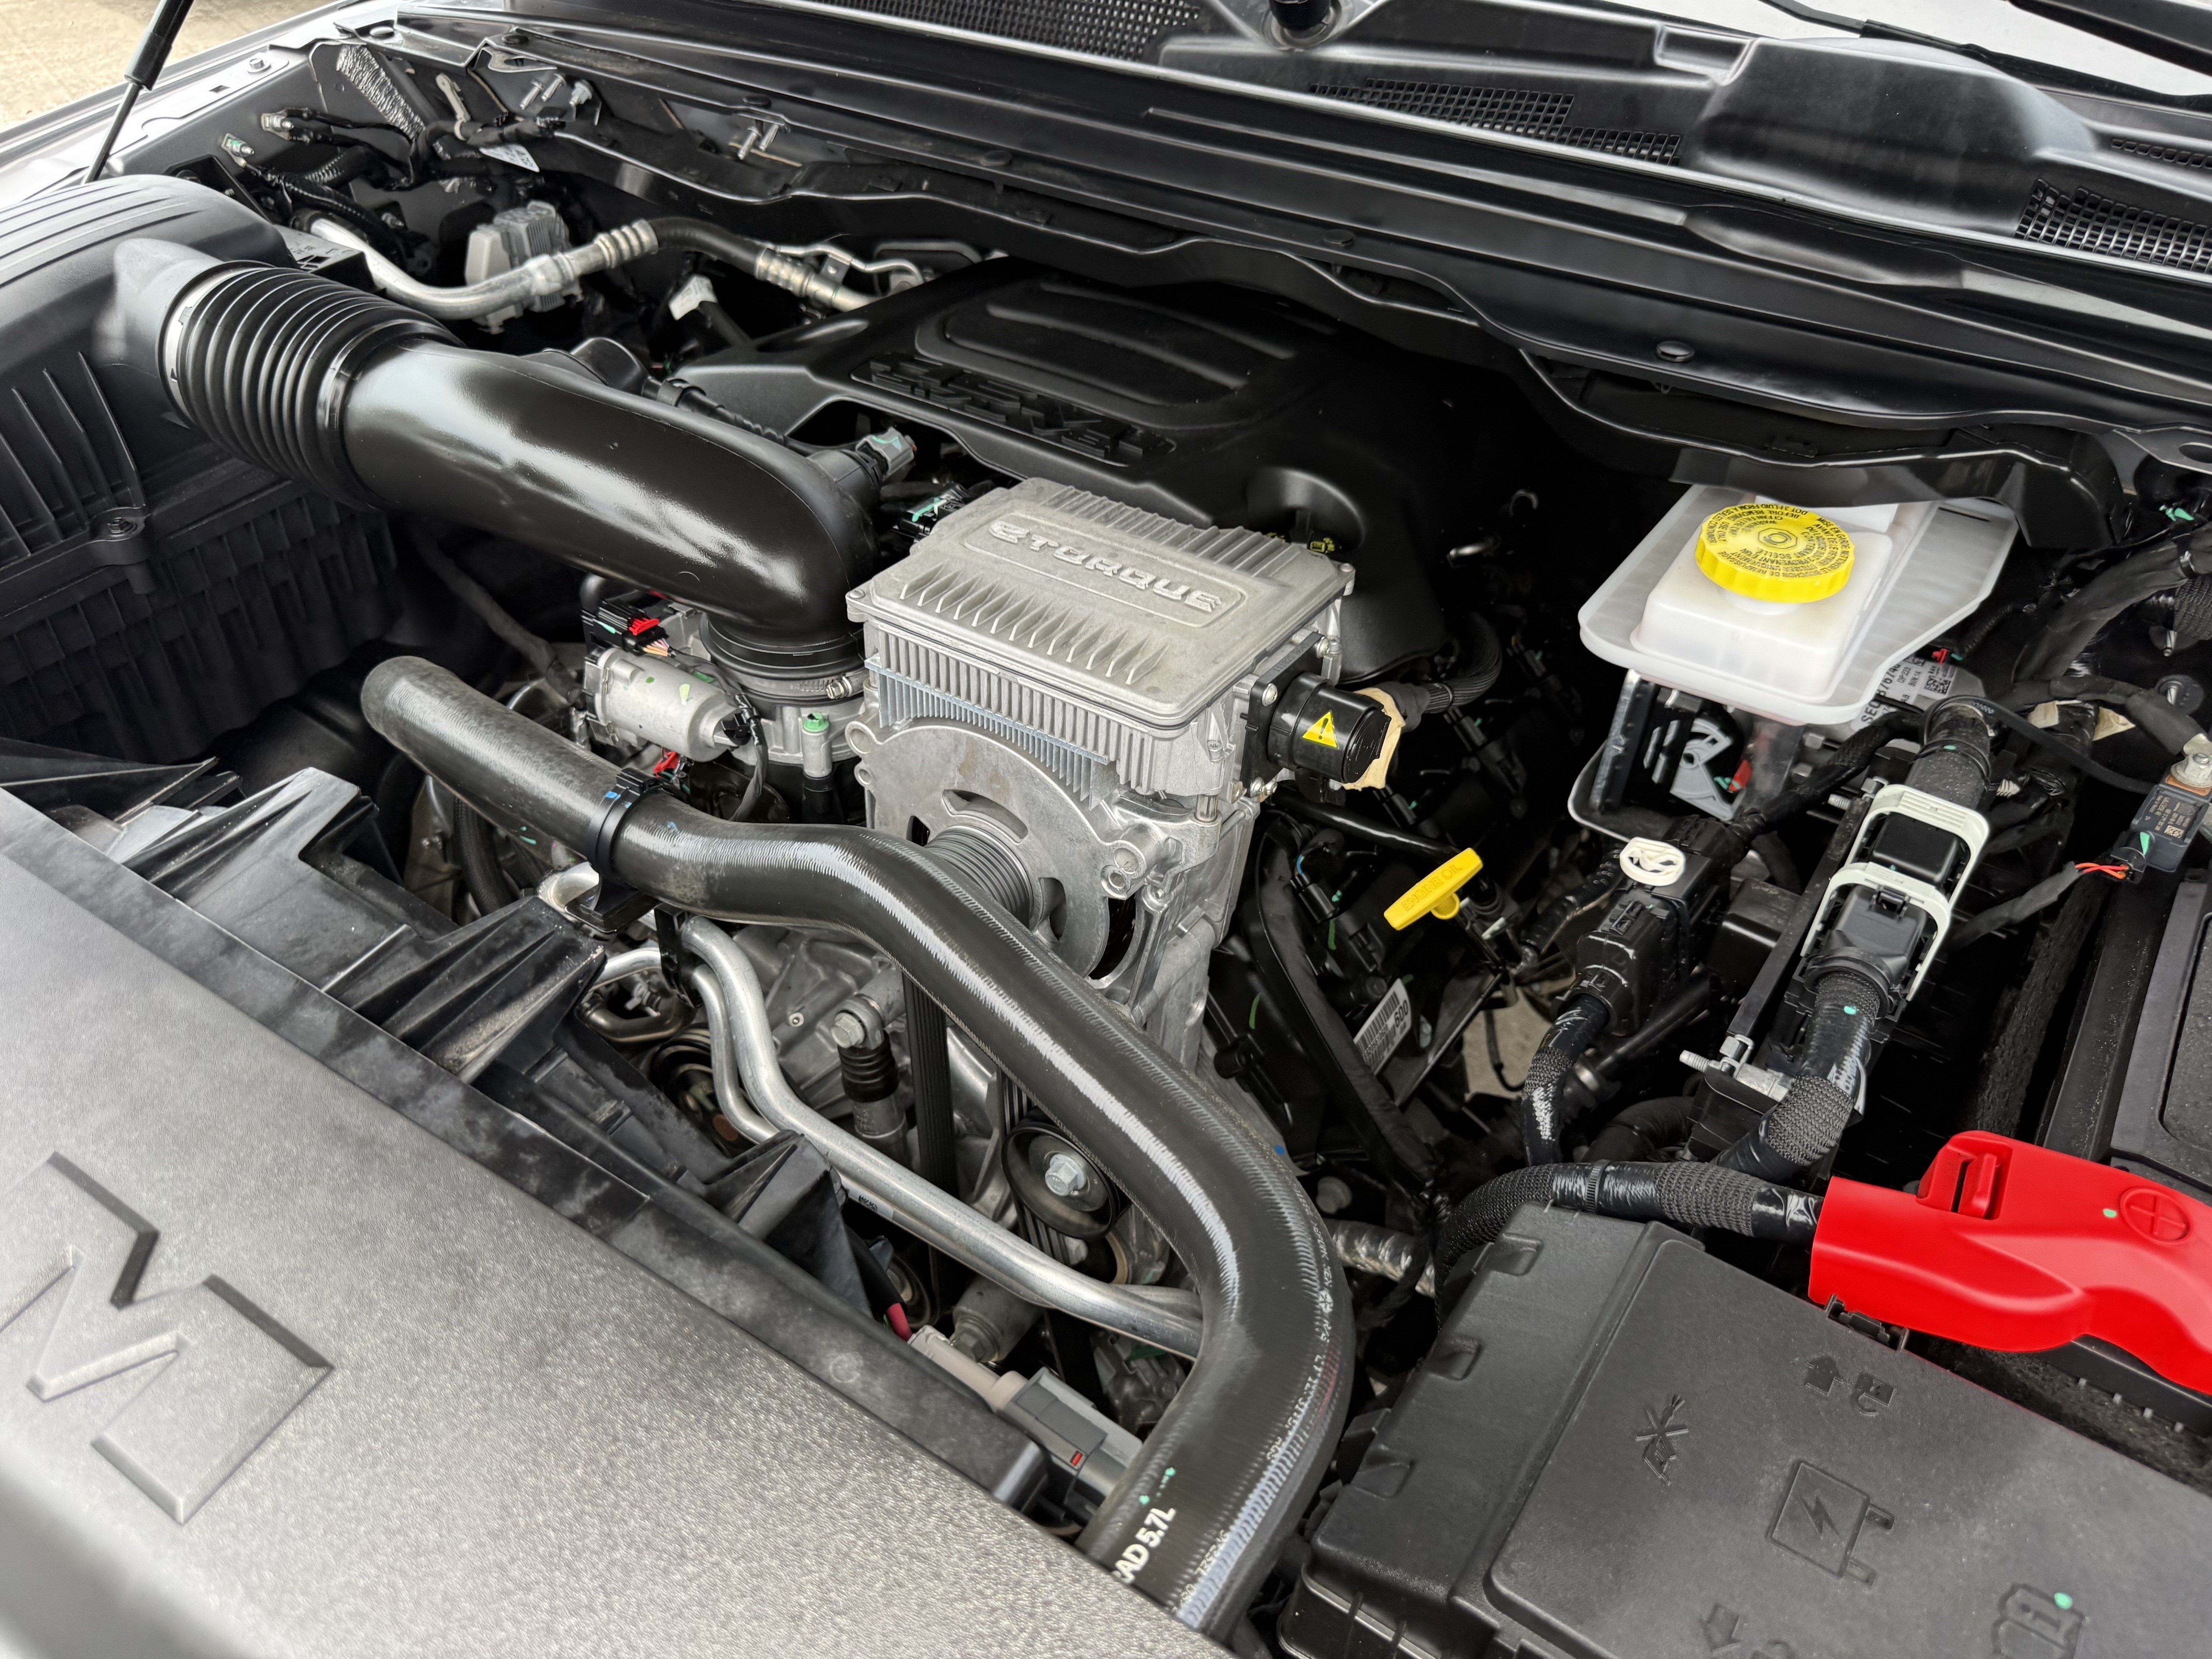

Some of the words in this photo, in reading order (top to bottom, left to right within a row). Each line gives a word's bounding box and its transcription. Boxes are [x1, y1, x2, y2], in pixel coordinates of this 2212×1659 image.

[1711, 508, 1734, 521] SEALED
[1767, 509, 1800, 519] BEFORE
[1718, 521, 1732, 530] USE
[1733, 516, 1757, 527] FILLER
[1815, 517, 1834, 527] MISE
[1812, 523, 1834, 536] AVANT
[1717, 530, 1730, 543] ONLY
[1793, 531, 1815, 558] CONTENANT
[1717, 551, 1767, 574] REMPLISSAGE
[1730, 551, 1780, 570] UNIQUEMENT
[1758, 556, 1810, 565] PROVENANT
[1401, 874, 1443, 912] ENGINE
[1440, 864, 1463, 884] OIL
[1135, 1507, 1176, 1547] 5.7L
